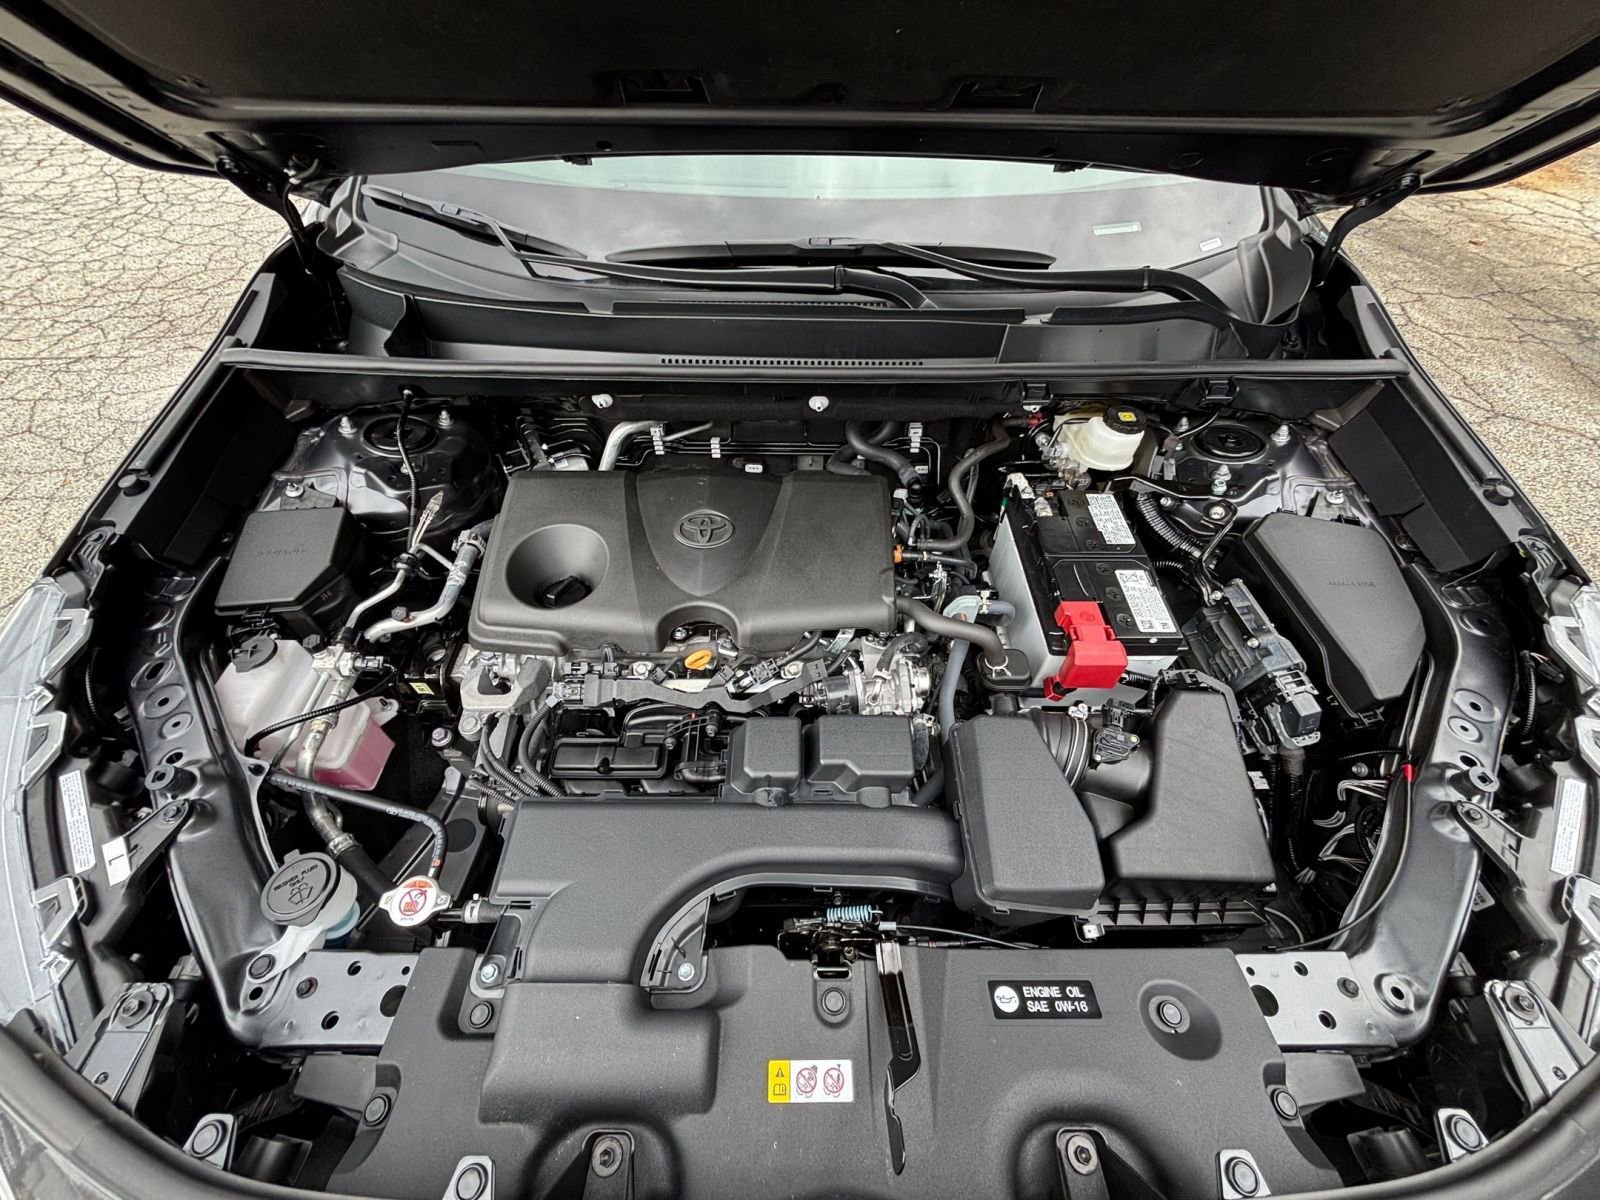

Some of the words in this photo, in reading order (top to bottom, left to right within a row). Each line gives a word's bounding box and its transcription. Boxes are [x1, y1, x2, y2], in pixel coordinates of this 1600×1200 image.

[1022, 986, 1062, 998] ENGINE
[1066, 986, 1085, 998] OIL
[1027, 1001, 1050, 1012] SAE
[1054, 1001, 1088, 1013] 0W-16
